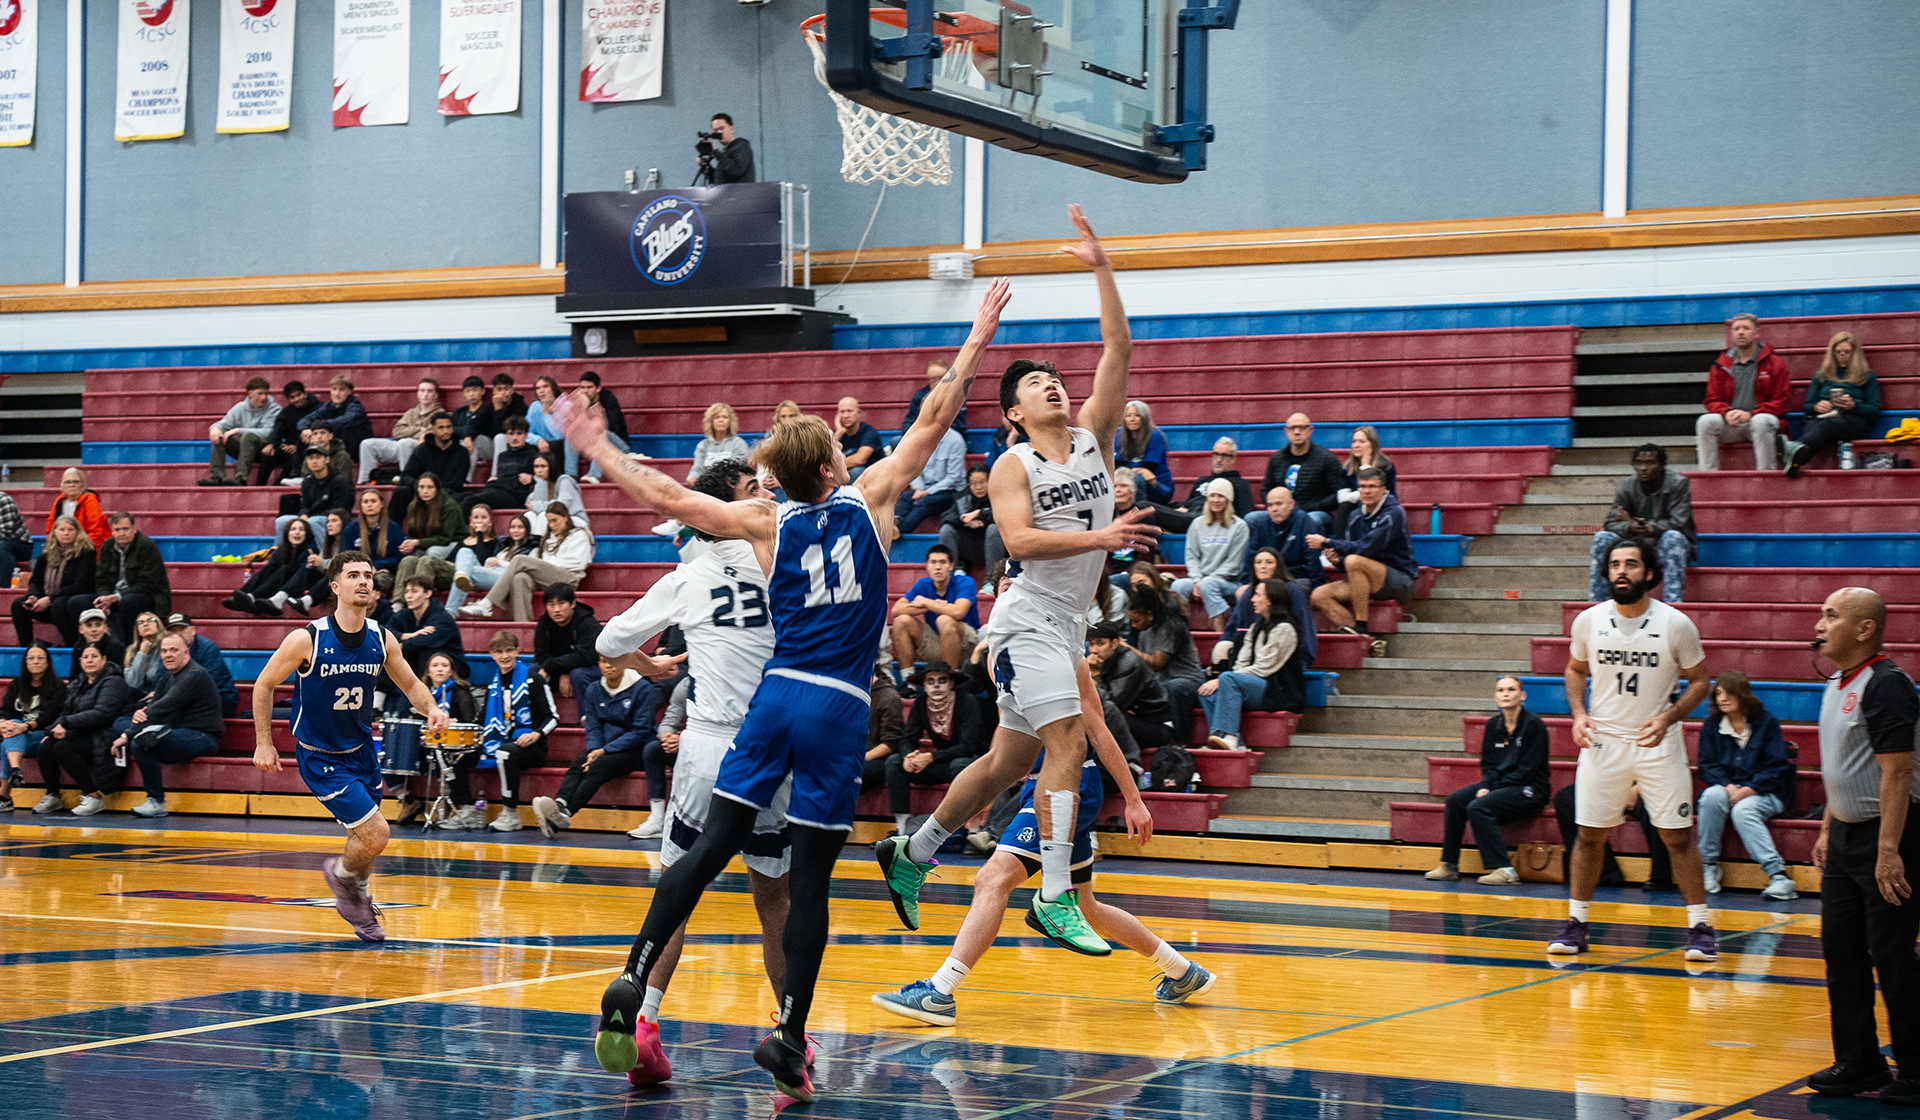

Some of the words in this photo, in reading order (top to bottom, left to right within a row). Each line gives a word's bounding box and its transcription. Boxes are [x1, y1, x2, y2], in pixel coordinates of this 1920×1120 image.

[349, 0, 394, 11] BADMINTON
[369, 7, 399, 17] SINGLES
[450, 5, 474, 17] SILVER
[340, 26, 364, 35] SILVER
[366, 23, 402, 33] MEDALIST
[465, 30, 499, 41] SOCCER
[596, 33, 653, 45] VOLLEYBALL
[460, 41, 504, 51] MASCULIN
[601, 44, 649, 55] MASCULIN
[246, 51, 272, 64] 2010
[141, 60, 169, 72] 2008
[232, 88, 284, 100] CHAMPIONS
[0, 101, 14, 111] OST
[634, 199, 678, 237] CAPILANO
[641, 209, 694, 274] Blues
[655, 235, 704, 281] UNIVERSITY
[1038, 472, 1109, 511] CAPILANO
[1077, 509, 1094, 531] 7
[800, 535, 863, 609] 11
[710, 581, 770, 628] 23
[1597, 649, 1660, 667] CAPILANO
[320, 663, 381, 678] CAMOSUN
[1616, 672, 1639, 697] 14
[333, 686, 364, 711] 23
